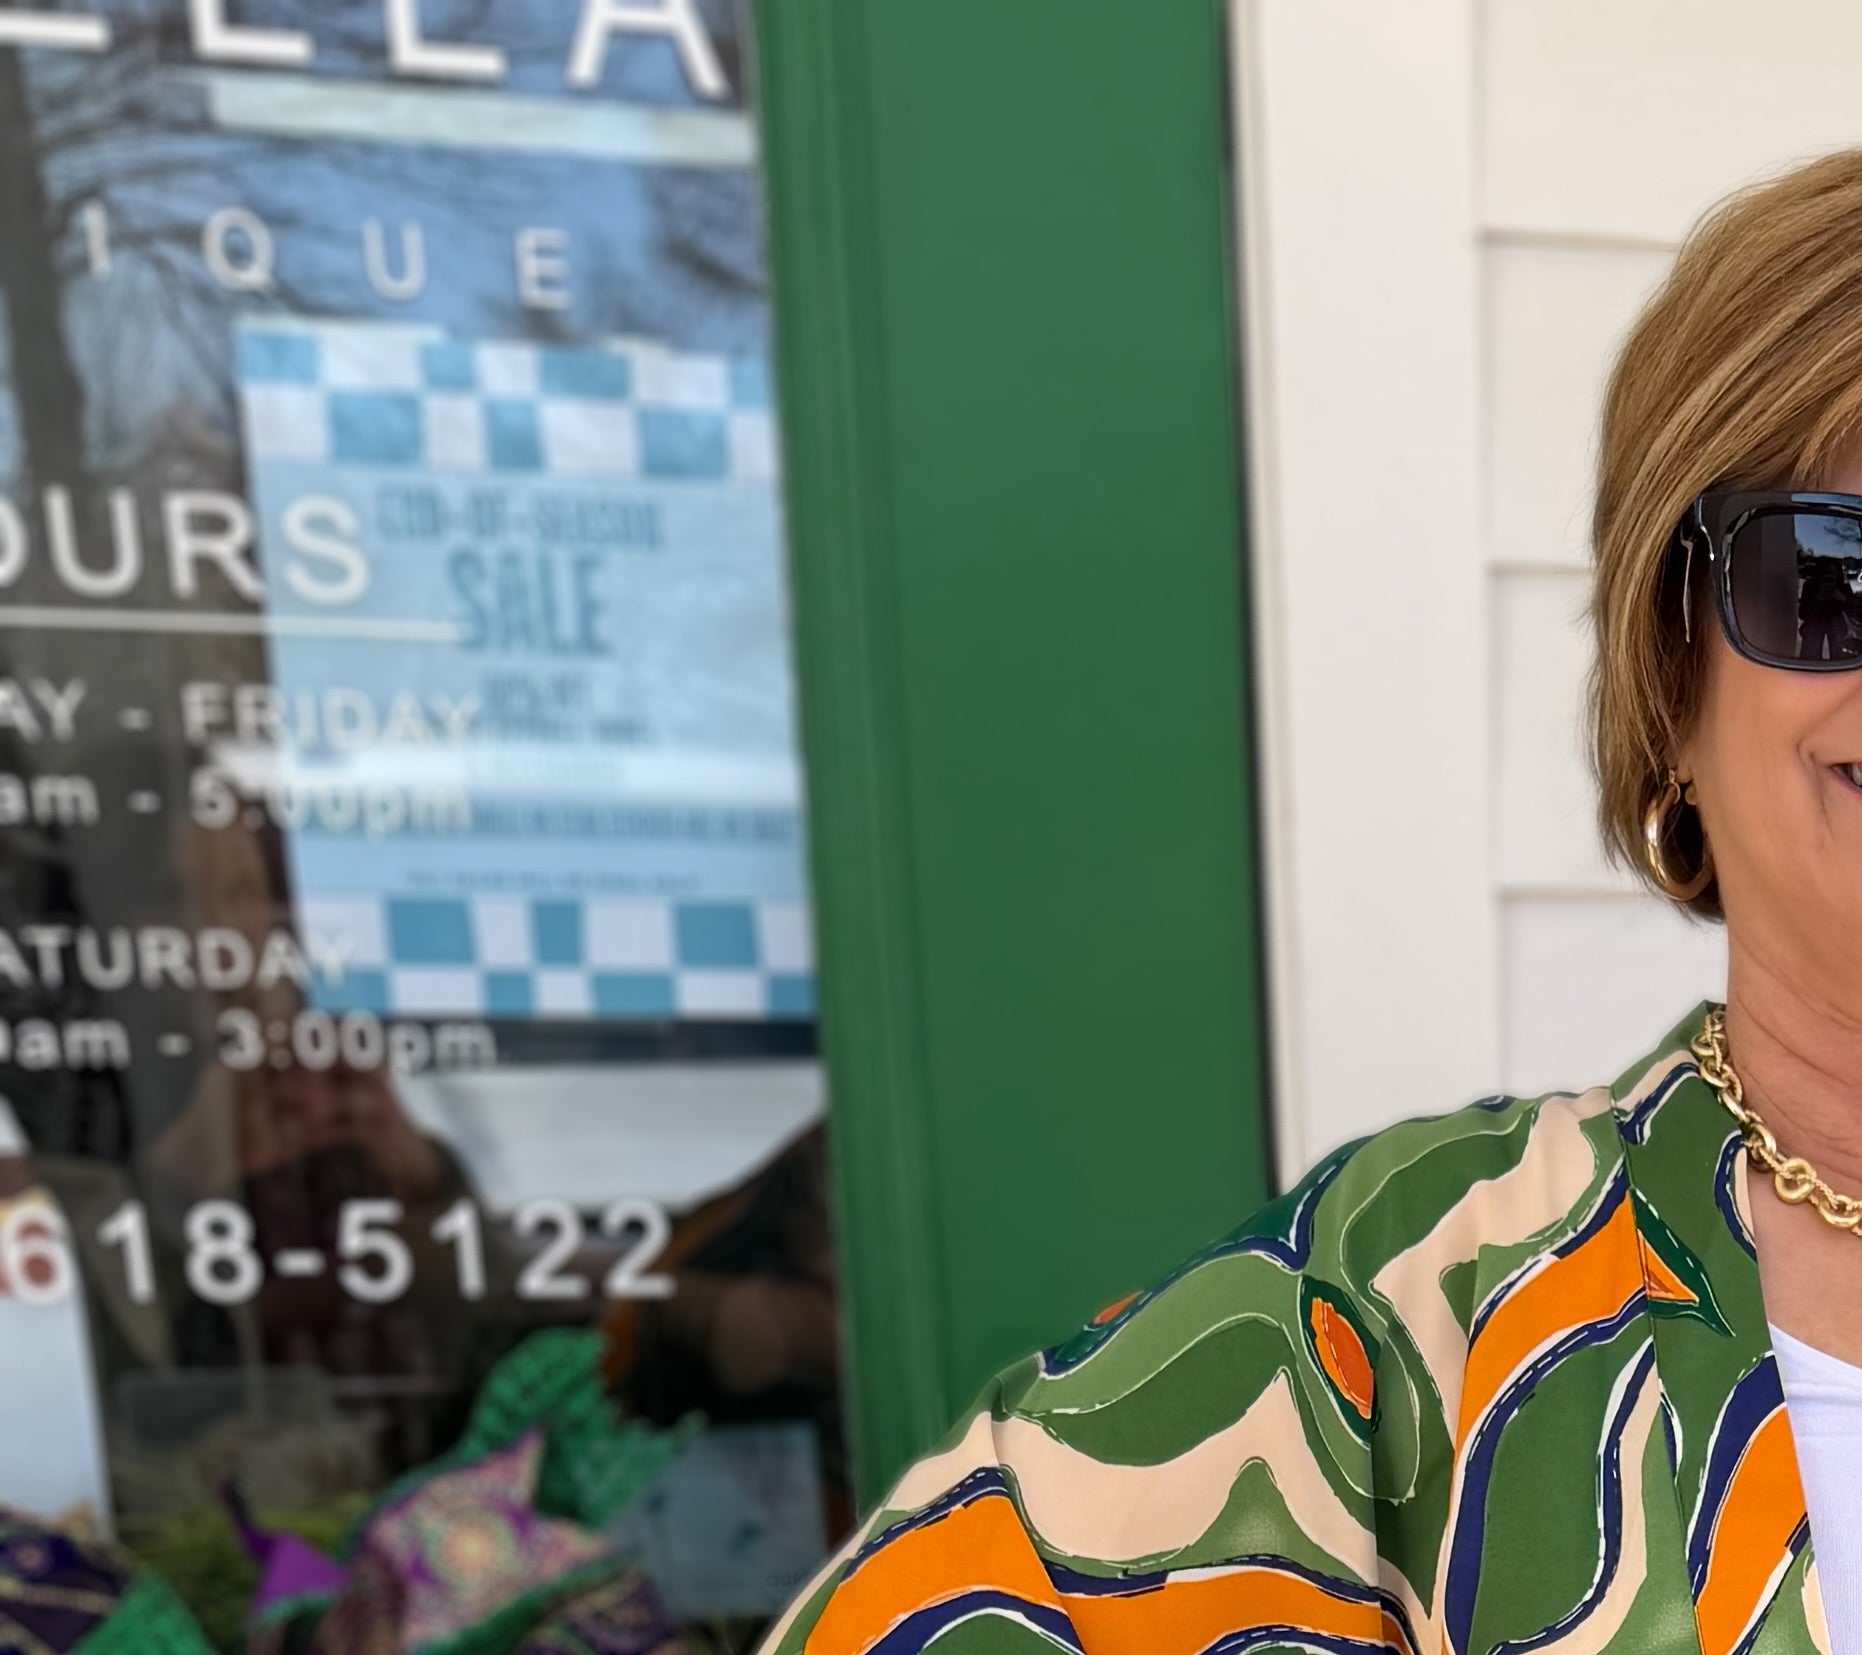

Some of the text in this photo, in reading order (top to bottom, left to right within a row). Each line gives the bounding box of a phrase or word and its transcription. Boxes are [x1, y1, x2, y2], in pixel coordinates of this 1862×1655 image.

[78, 198, 576, 312] IQUE
[0, 482, 371, 606] URS
[448, 546, 616, 658] SALE
[180, 681, 481, 752] FRIDAY
[0, 1015, 132, 1072] am
[215, 1005, 499, 1084] 3:00pm
[2, 1199, 678, 1306] 618-5122
